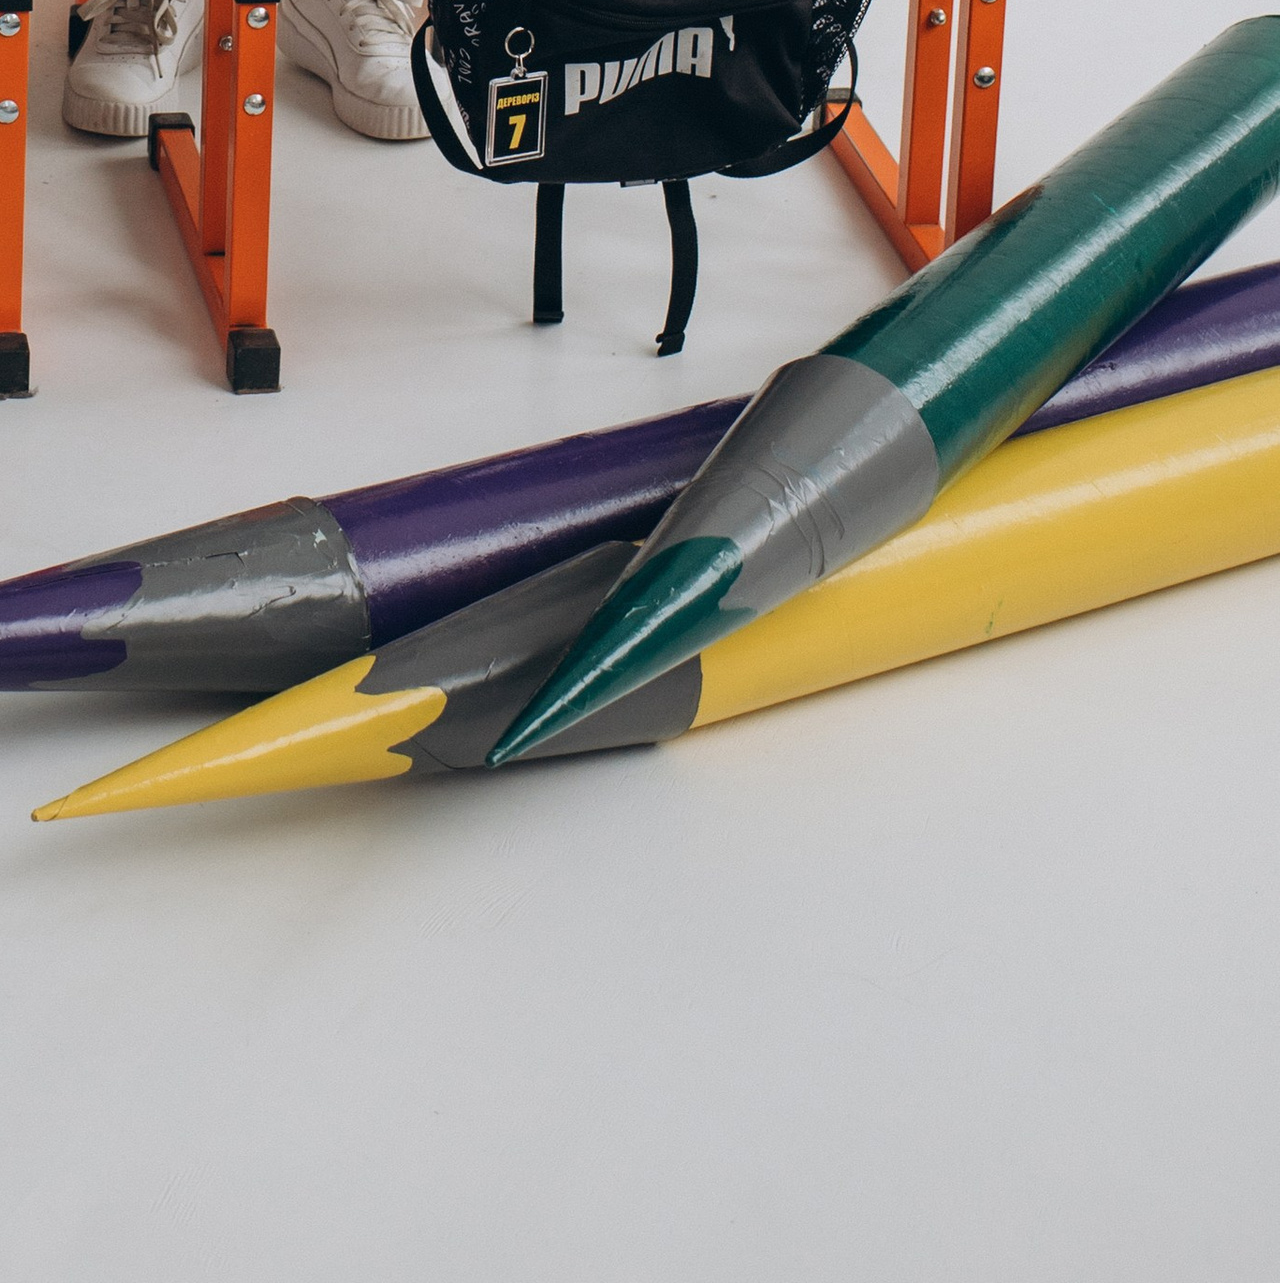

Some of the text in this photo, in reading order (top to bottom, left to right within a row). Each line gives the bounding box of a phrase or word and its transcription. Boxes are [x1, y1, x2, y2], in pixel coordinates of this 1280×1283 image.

[564, 26, 715, 116] PUMA
[496, 92, 540, 110] ДЕРЕВОРІЗ
[508, 114, 527, 150] 7
